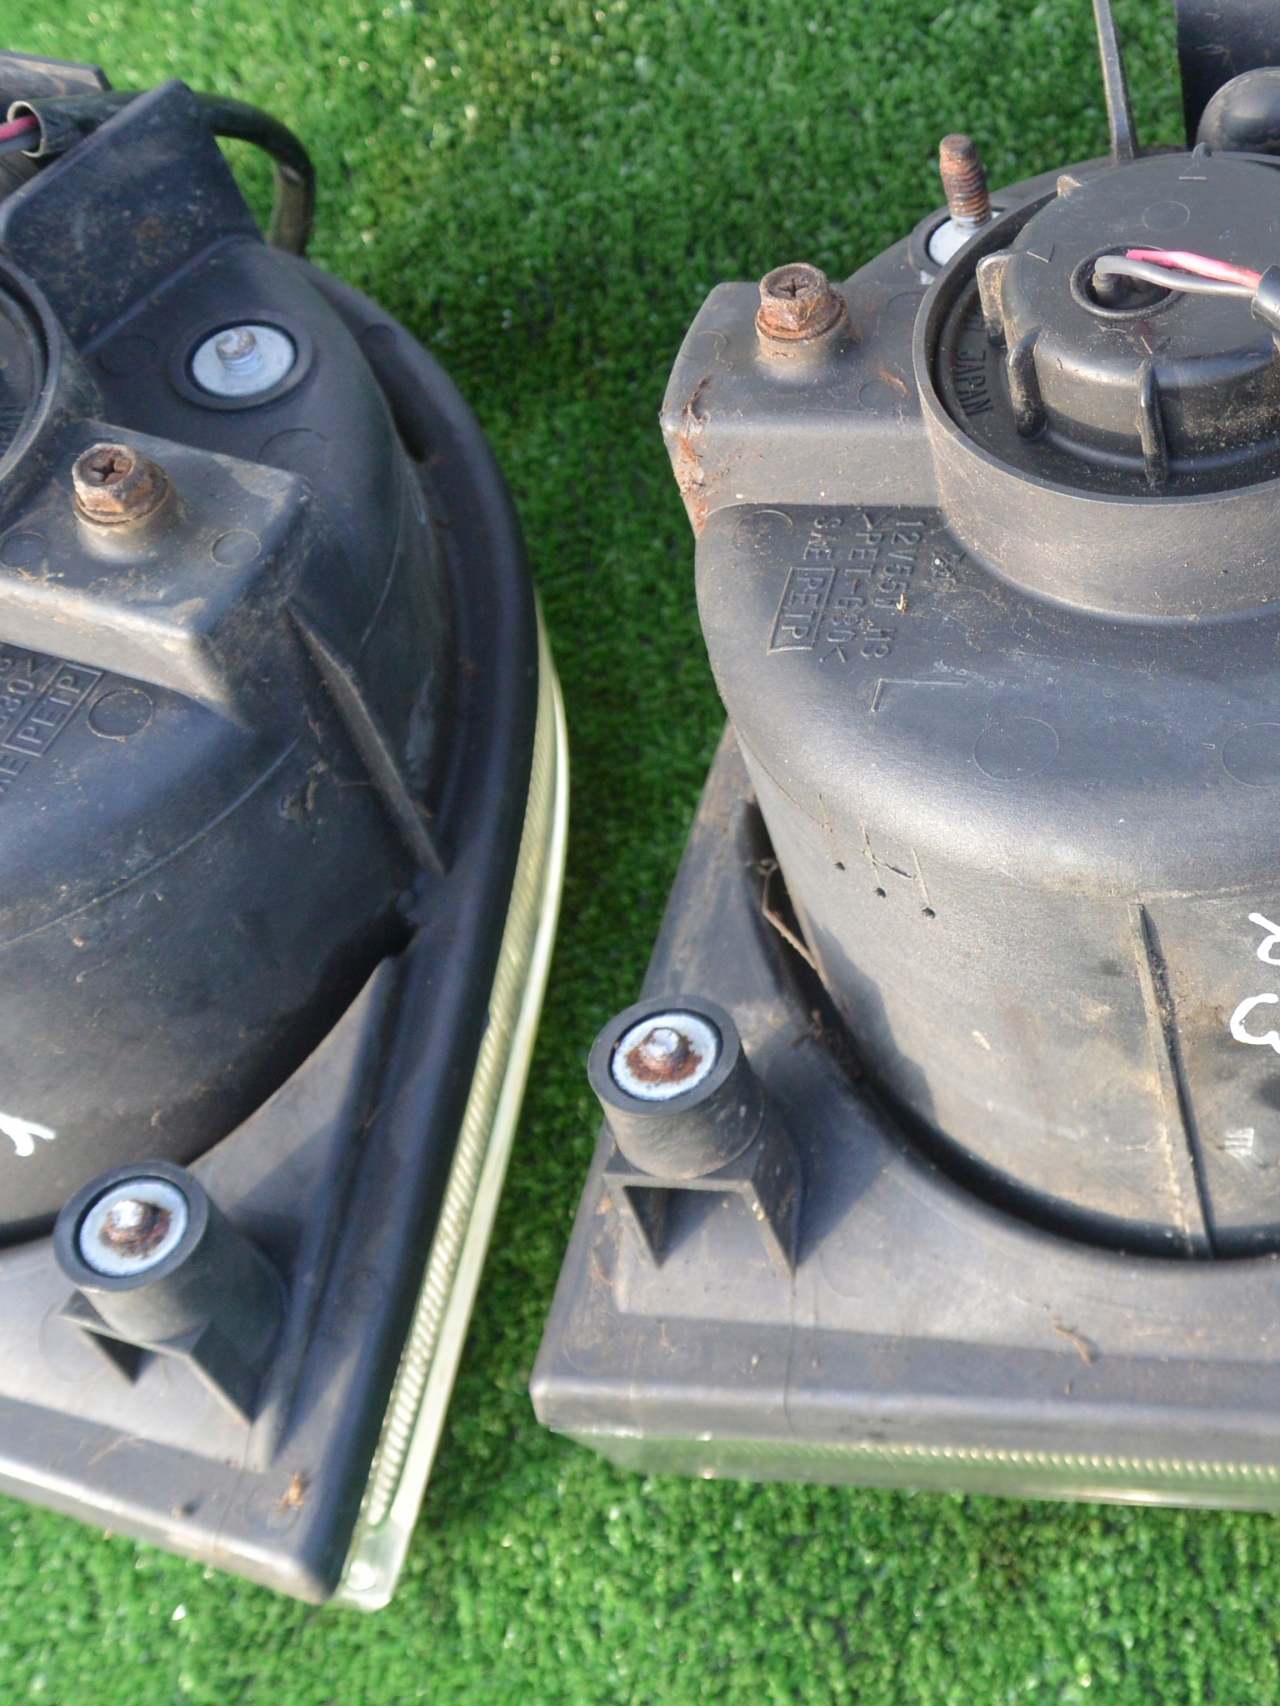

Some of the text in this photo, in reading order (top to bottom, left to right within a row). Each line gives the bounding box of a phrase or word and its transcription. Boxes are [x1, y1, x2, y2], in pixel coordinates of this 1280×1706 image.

[955, 350, 994, 416] JAPAN
[781, 577, 825, 639] PETP
[18, 676, 80, 743] PETP
